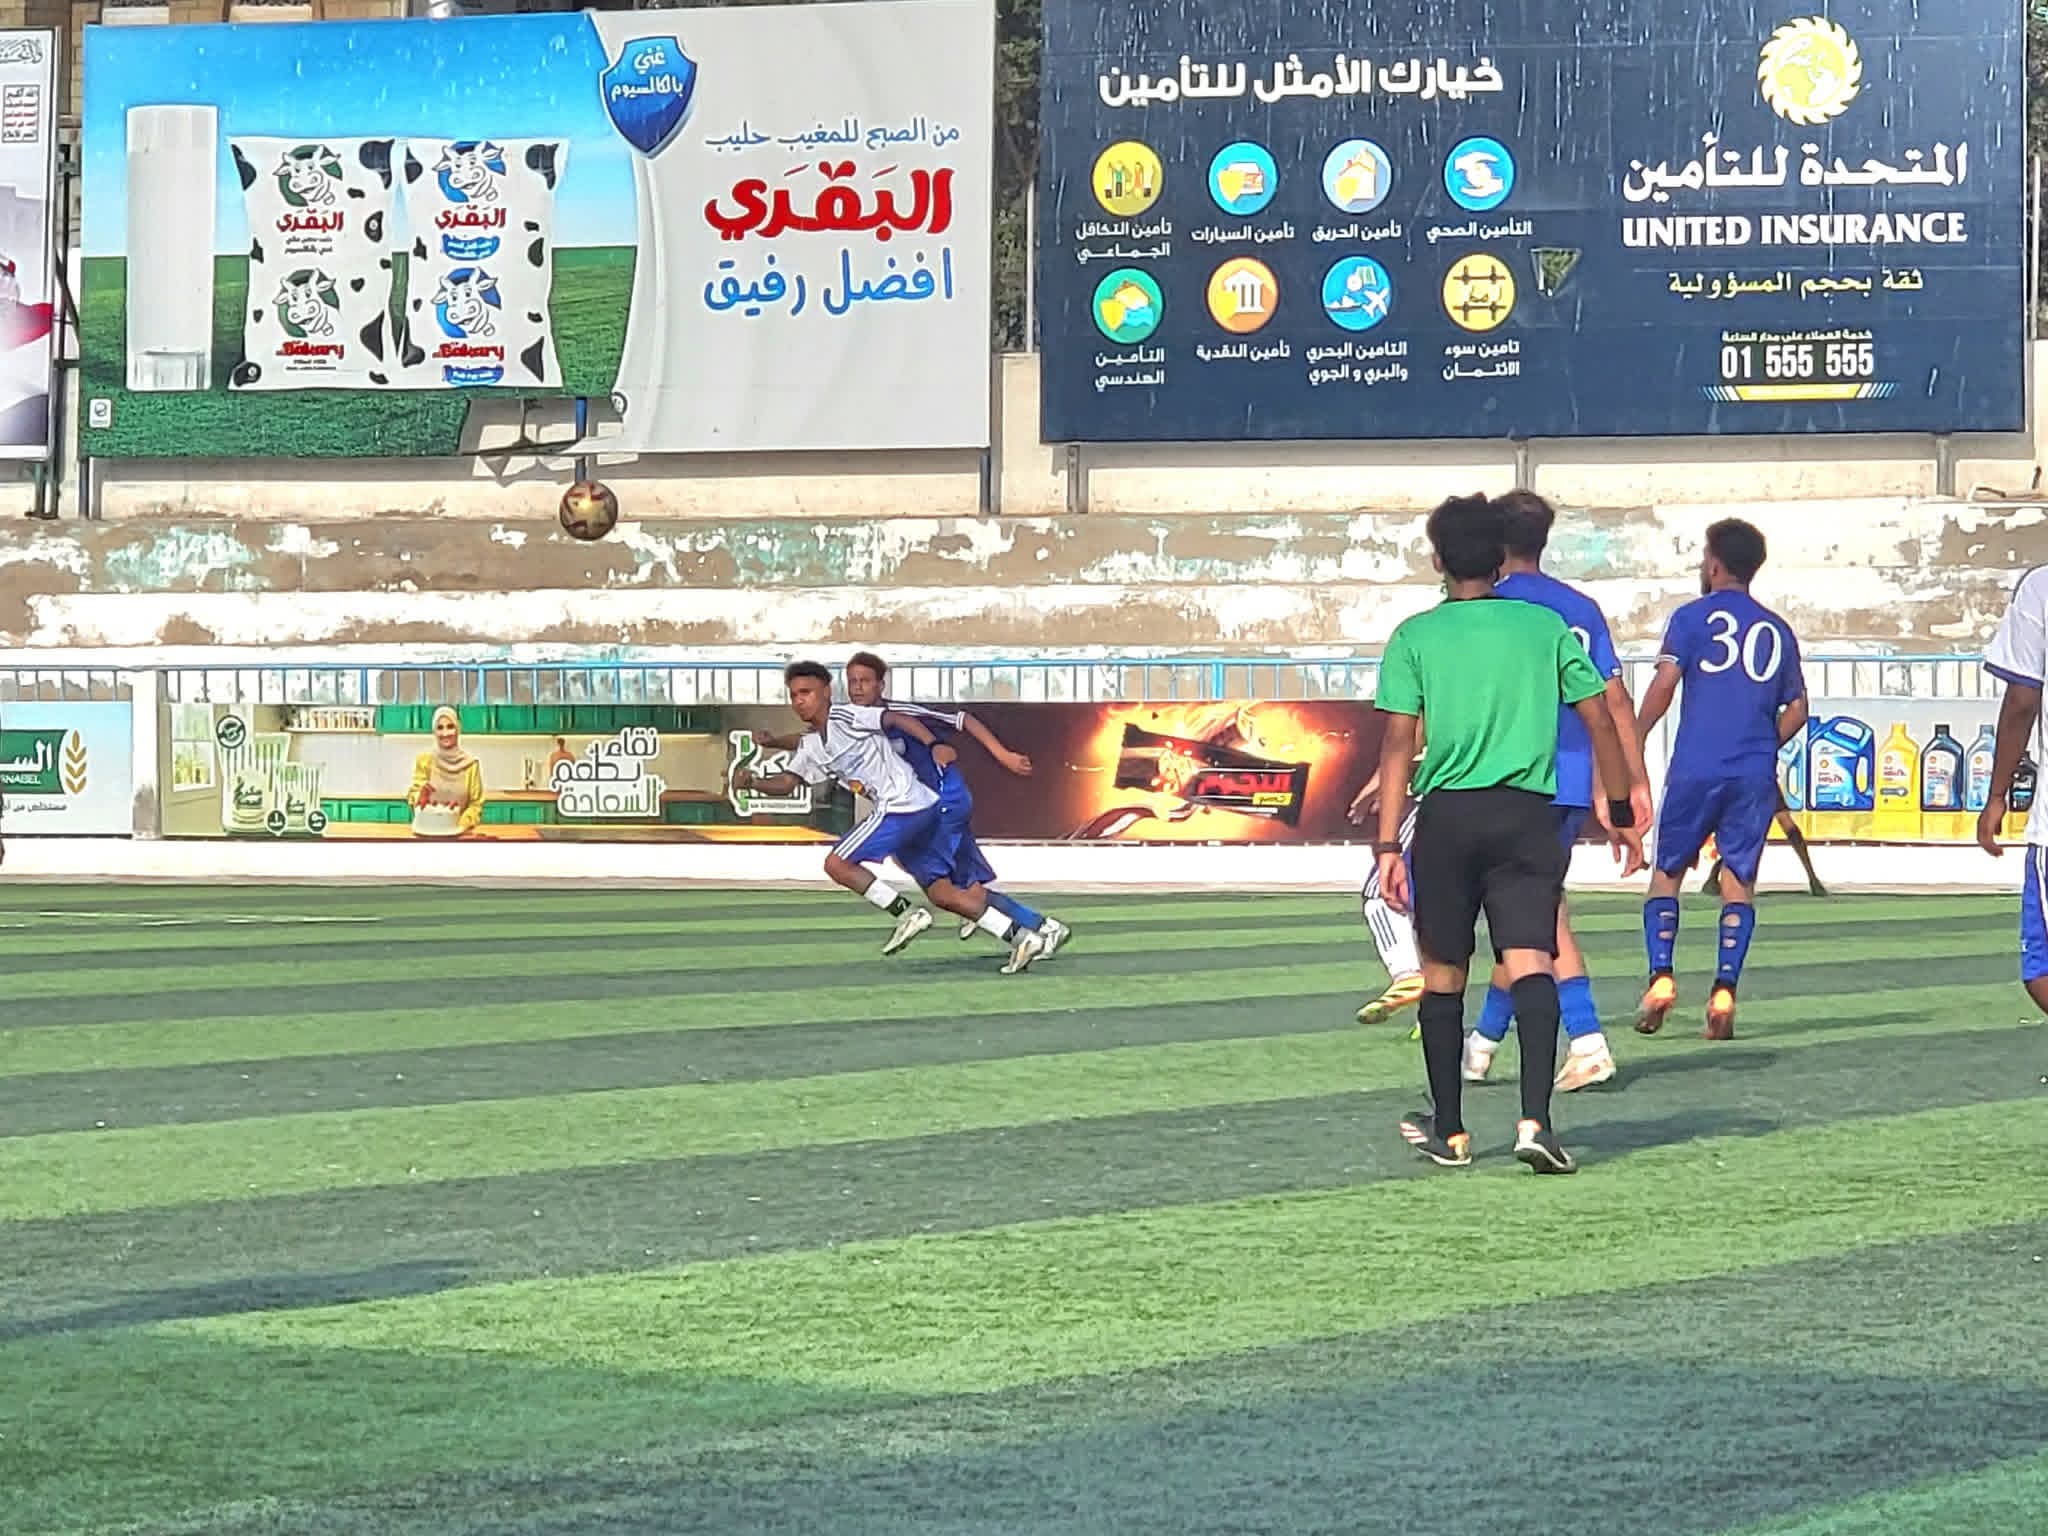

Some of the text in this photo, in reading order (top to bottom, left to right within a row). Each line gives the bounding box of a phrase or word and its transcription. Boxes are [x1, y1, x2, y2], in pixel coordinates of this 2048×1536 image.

[633, 45, 666, 75] غني
[611, 73, 684, 102] بالكالسيوم
[1099, 53, 1504, 107] خيارك الأمثل للتأمين
[705, 117, 960, 152] من الصبح للمغيب حليب
[1622, 131, 1968, 203] المتحدة للتأمين
[1075, 217, 1173, 240] تأمين التكافل
[1191, 221, 1295, 244] تأمين السيارات
[1311, 218, 1402, 242] تأمين الحريق
[1425, 217, 1533, 243] التأمين الصحي
[1622, 212, 1968, 247] UNITED INSURANCE
[1076, 241, 1171, 264] الجماعي
[703, 247, 953, 316] افضل رفيق
[1799, 273, 1872, 300] بحجم
[1881, 265, 1924, 290] ثقة
[1721, 330, 1757, 342] الساعة
[1094, 345, 1166, 366] التأمين
[1196, 340, 1291, 361] تأمين النقدية
[1306, 342, 1353, 363] البحري
[1444, 344, 1476, 358] سوء
[1721, 343, 1874, 379] 01 555 555
[1094, 369, 1166, 389] الهندسي
[1308, 363, 1409, 386] والبري و الجوي
[1699, 610, 1782, 683] 30
[605, 729, 658, 757] نقاء
[551, 743, 641, 789] بطعم
[561, 778, 657, 814] السعادة
